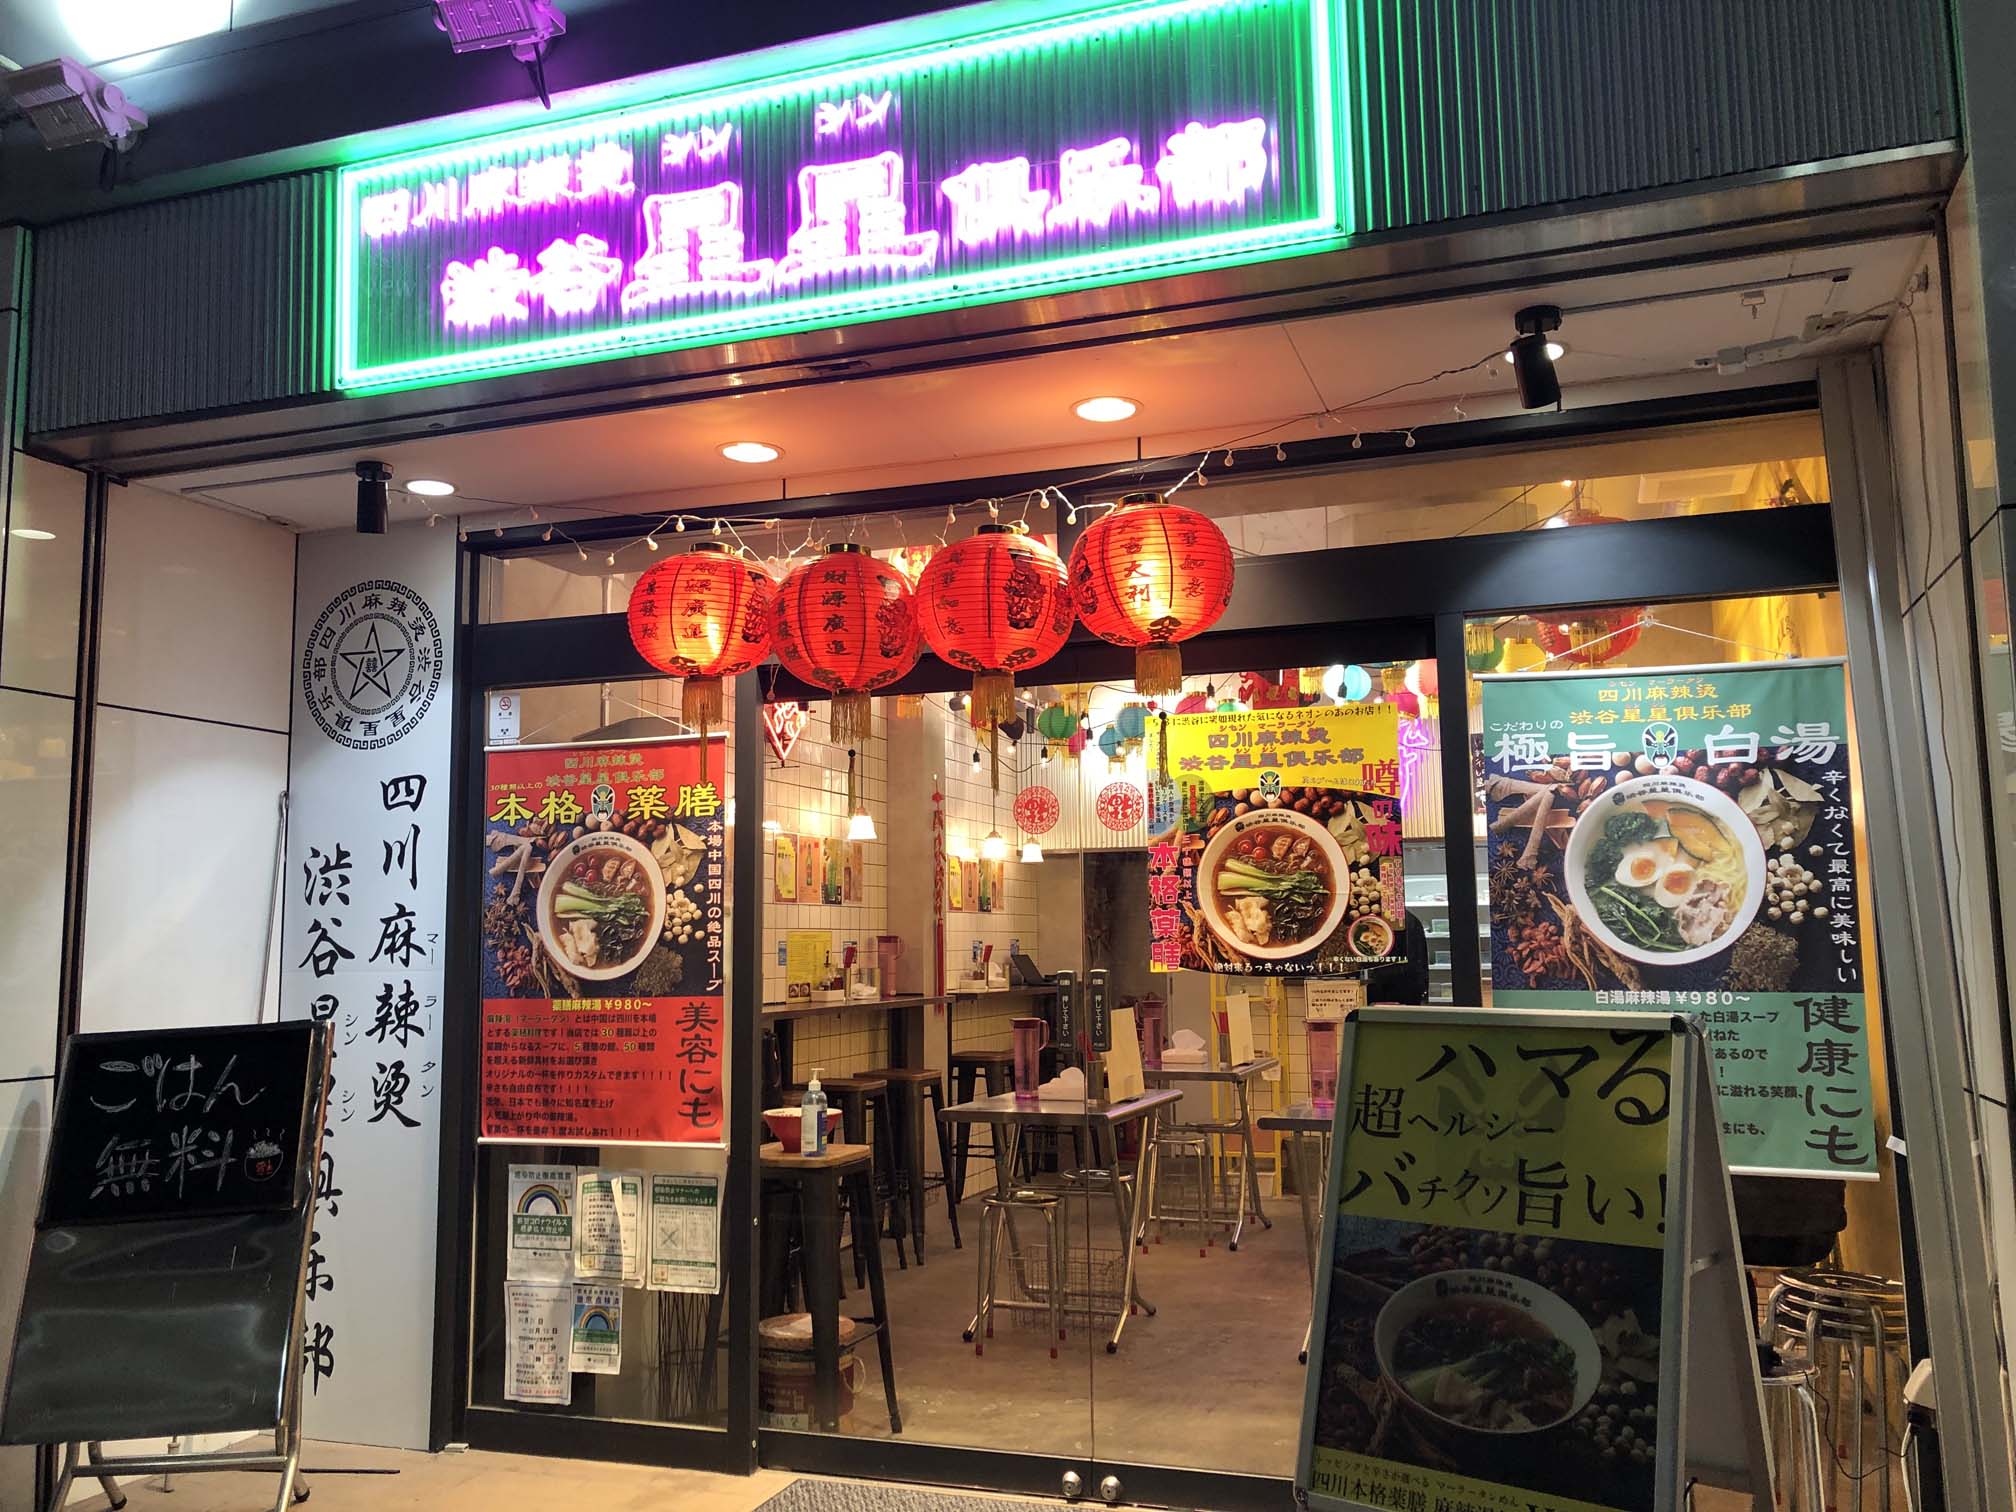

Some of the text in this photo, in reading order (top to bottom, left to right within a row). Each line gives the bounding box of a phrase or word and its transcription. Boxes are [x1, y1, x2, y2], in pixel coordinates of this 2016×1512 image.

[1119, 519, 1152, 602] 大吉大利
[1219, 724, 1247, 732] シセン
[1489, 720, 1564, 732] こだわりの
[1491, 731, 1618, 774] 極旨
[1704, 722, 1840, 766] 白湯
[490, 783, 723, 827] 本格 薬膳
[706, 820, 723, 991] 本場中国四川の絶品スープ
[1148, 841, 1181, 971] 本格薬膳
[1821, 770, 1858, 984] 辛くなくて最高に美味しい
[366, 772, 427, 1128] 四川麻辣烫
[1595, 990, 1671, 1005] 白湯麻辣湯
[91, 1052, 266, 1113] ごはん
[675, 1002, 718, 1130] 美容にも
[1415, 1029, 1672, 1126] ハマる
[1794, 996, 1868, 1166] 健康にも
[1351, 1083, 1555, 1139] 超ヘルシー
[90, 1125, 239, 1199] 無料
